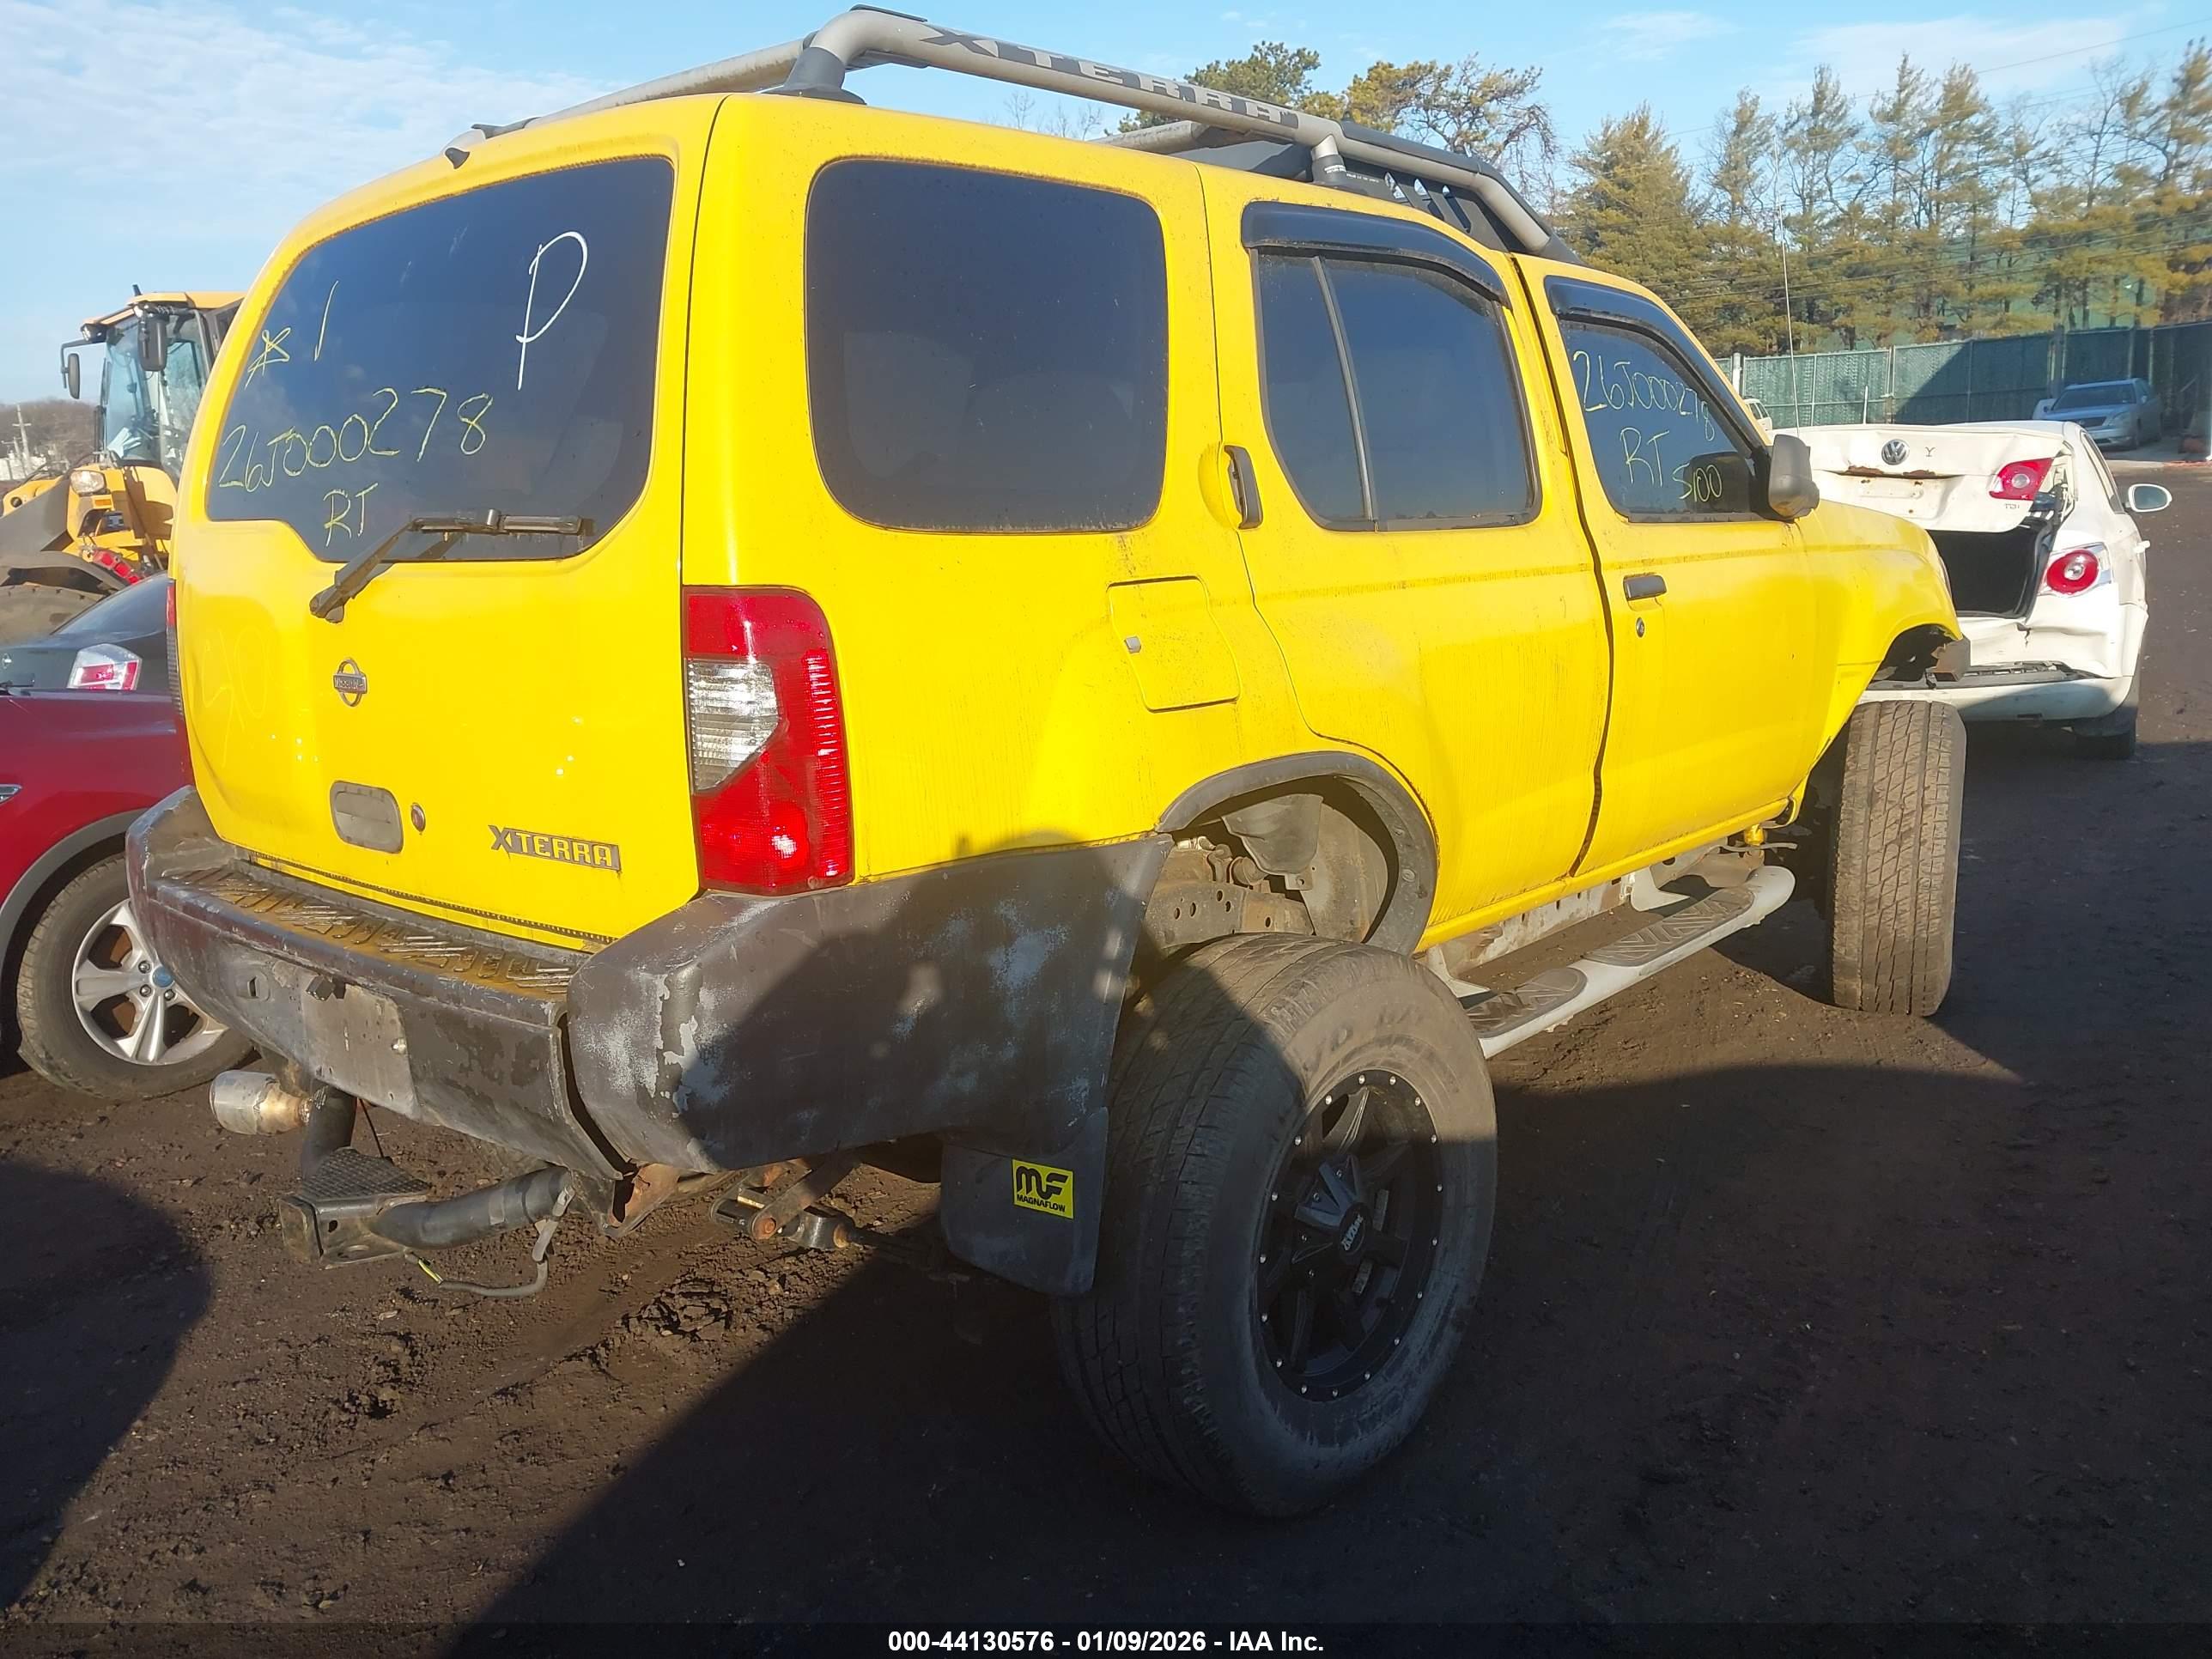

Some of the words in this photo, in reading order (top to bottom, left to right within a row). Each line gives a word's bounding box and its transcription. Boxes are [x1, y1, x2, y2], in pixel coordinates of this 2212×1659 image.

[920, 25, 1299, 130] XTERRA
[515, 231, 589, 391] P
[1620, 427, 1670, 489] RT
[322, 482, 379, 548] RT
[488, 824, 622, 872] XTERRA
[1017, 1194, 1066, 1212] MAGNAFLOW
